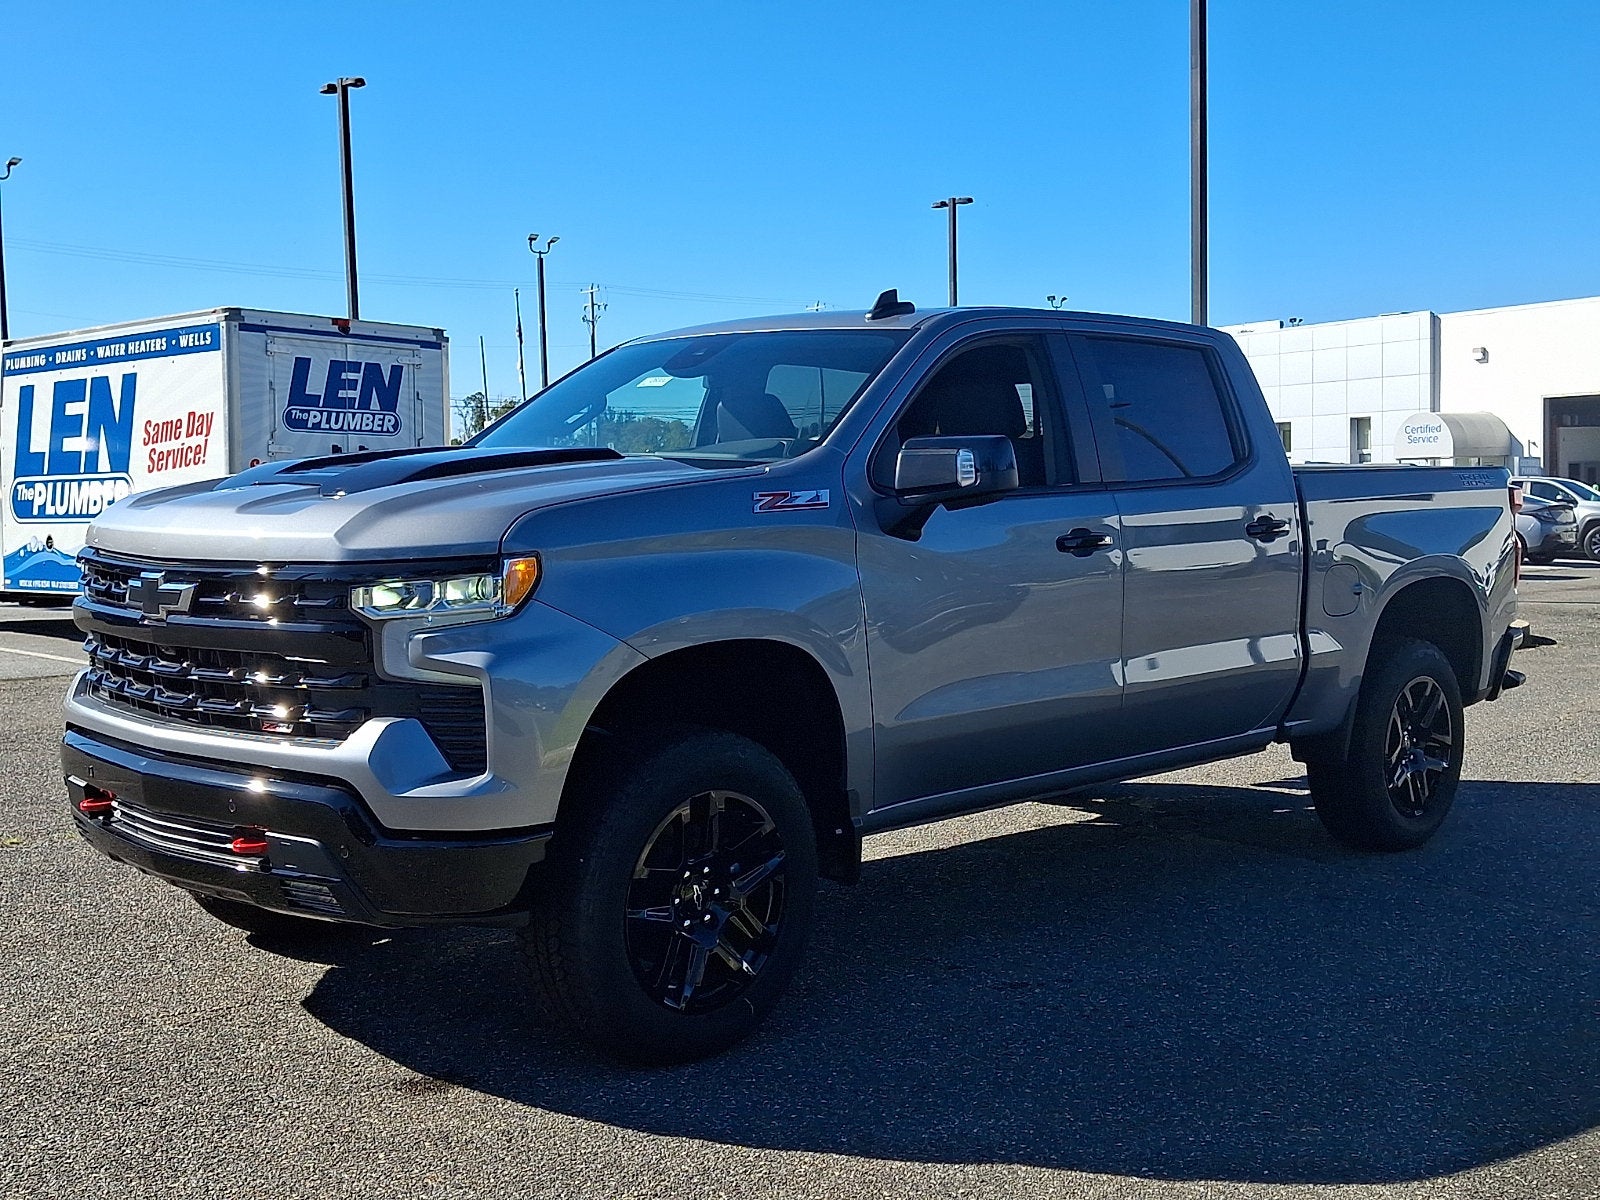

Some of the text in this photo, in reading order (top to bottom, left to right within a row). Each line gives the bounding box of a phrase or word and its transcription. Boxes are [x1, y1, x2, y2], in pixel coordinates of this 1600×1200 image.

[5, 331, 212, 371] PLUMBING DRAINS WATER HEATERS WELLS
[287, 356, 404, 411] LEN
[14, 372, 138, 476] LEN
[143, 411, 214, 446] Same Day
[291, 410, 396, 432] The PLUMBER
[1404, 424, 1442, 435] Certified
[1407, 434, 1439, 444] Service
[147, 438, 208, 474] Service!
[16, 484, 35, 501] The
[753, 489, 830, 513] Z71
